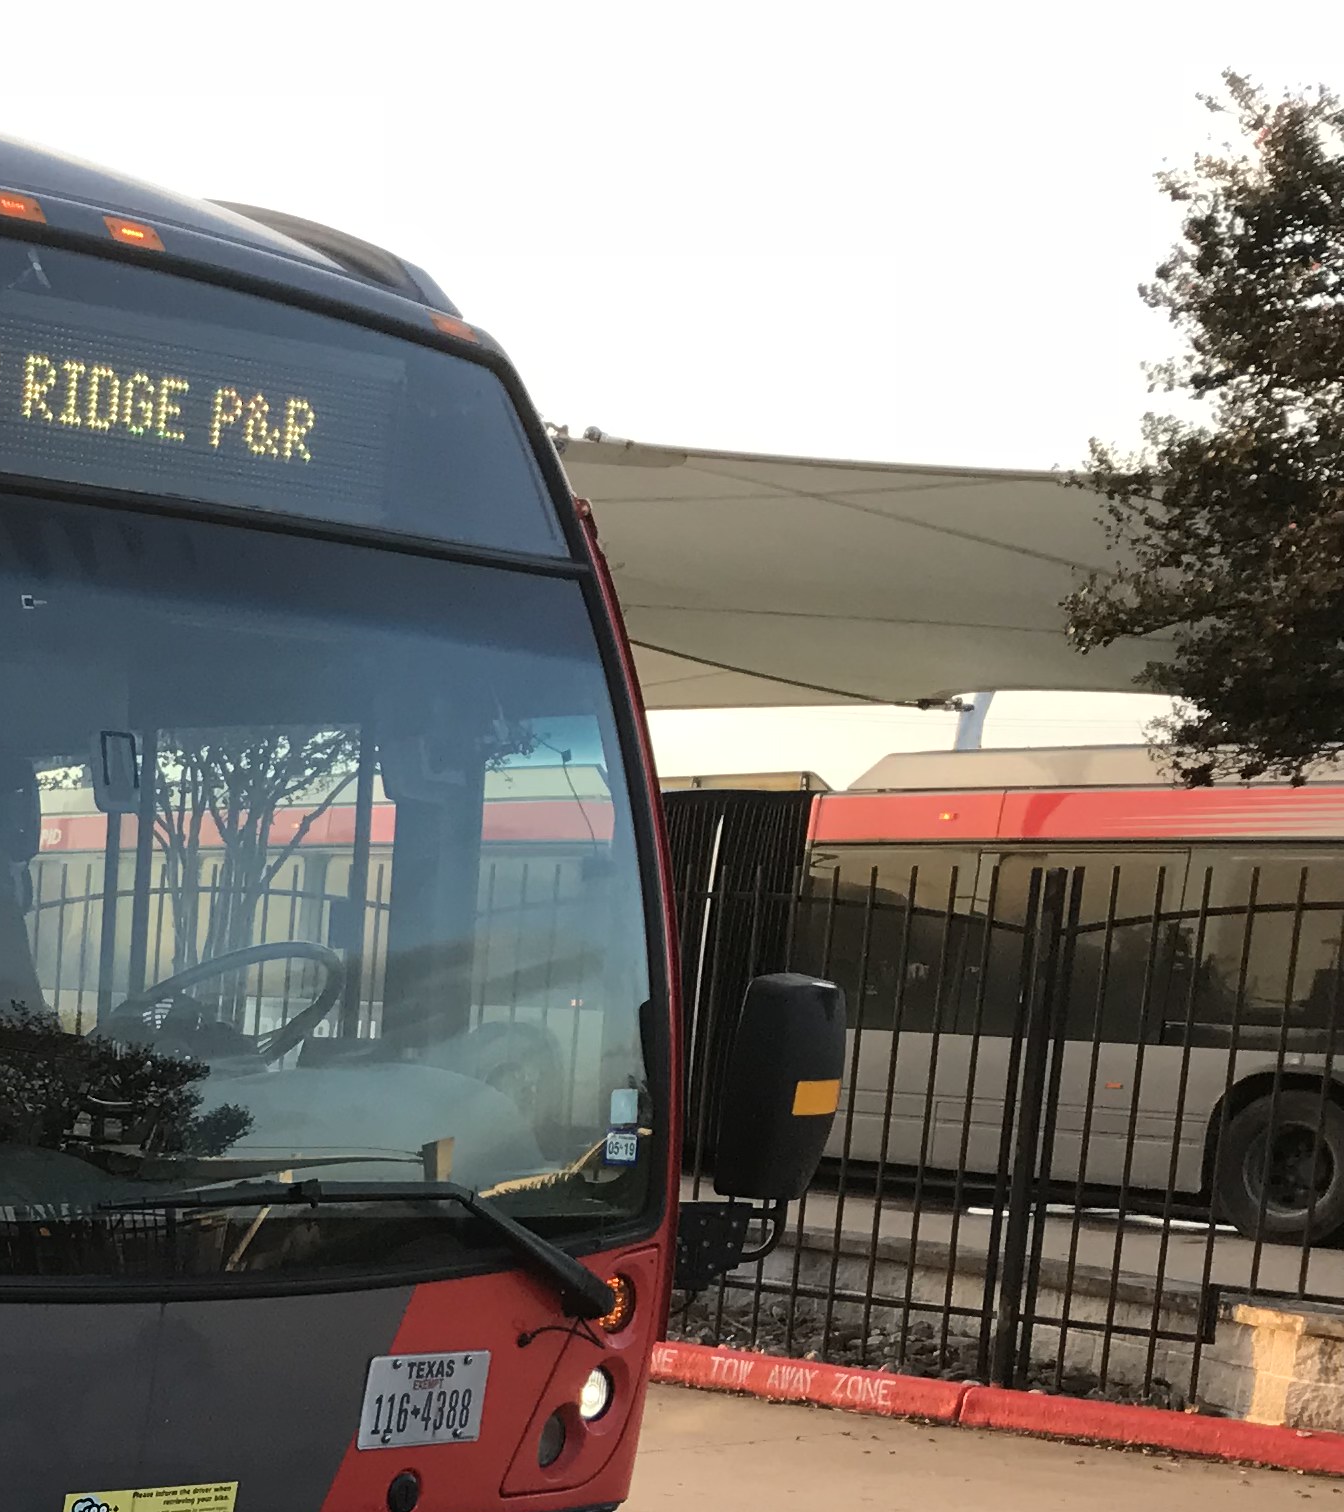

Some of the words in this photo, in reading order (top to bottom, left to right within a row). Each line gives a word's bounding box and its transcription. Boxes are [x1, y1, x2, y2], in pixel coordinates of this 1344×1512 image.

[22, 353, 192, 442] RIDGE
[209, 386, 317, 463] P&R
[407, 1359, 455, 1379] TEXAS
[413, 1378, 444, 1391] EXEMPT
[711, 1355, 755, 1384] TOW
[766, 1364, 820, 1394] AWAY
[830, 1372, 897, 1406] ZONE
[193, 1487, 212, 1495] driver
[163, 1498, 195, 1506] retrieving
[197, 1497, 212, 1505] your
